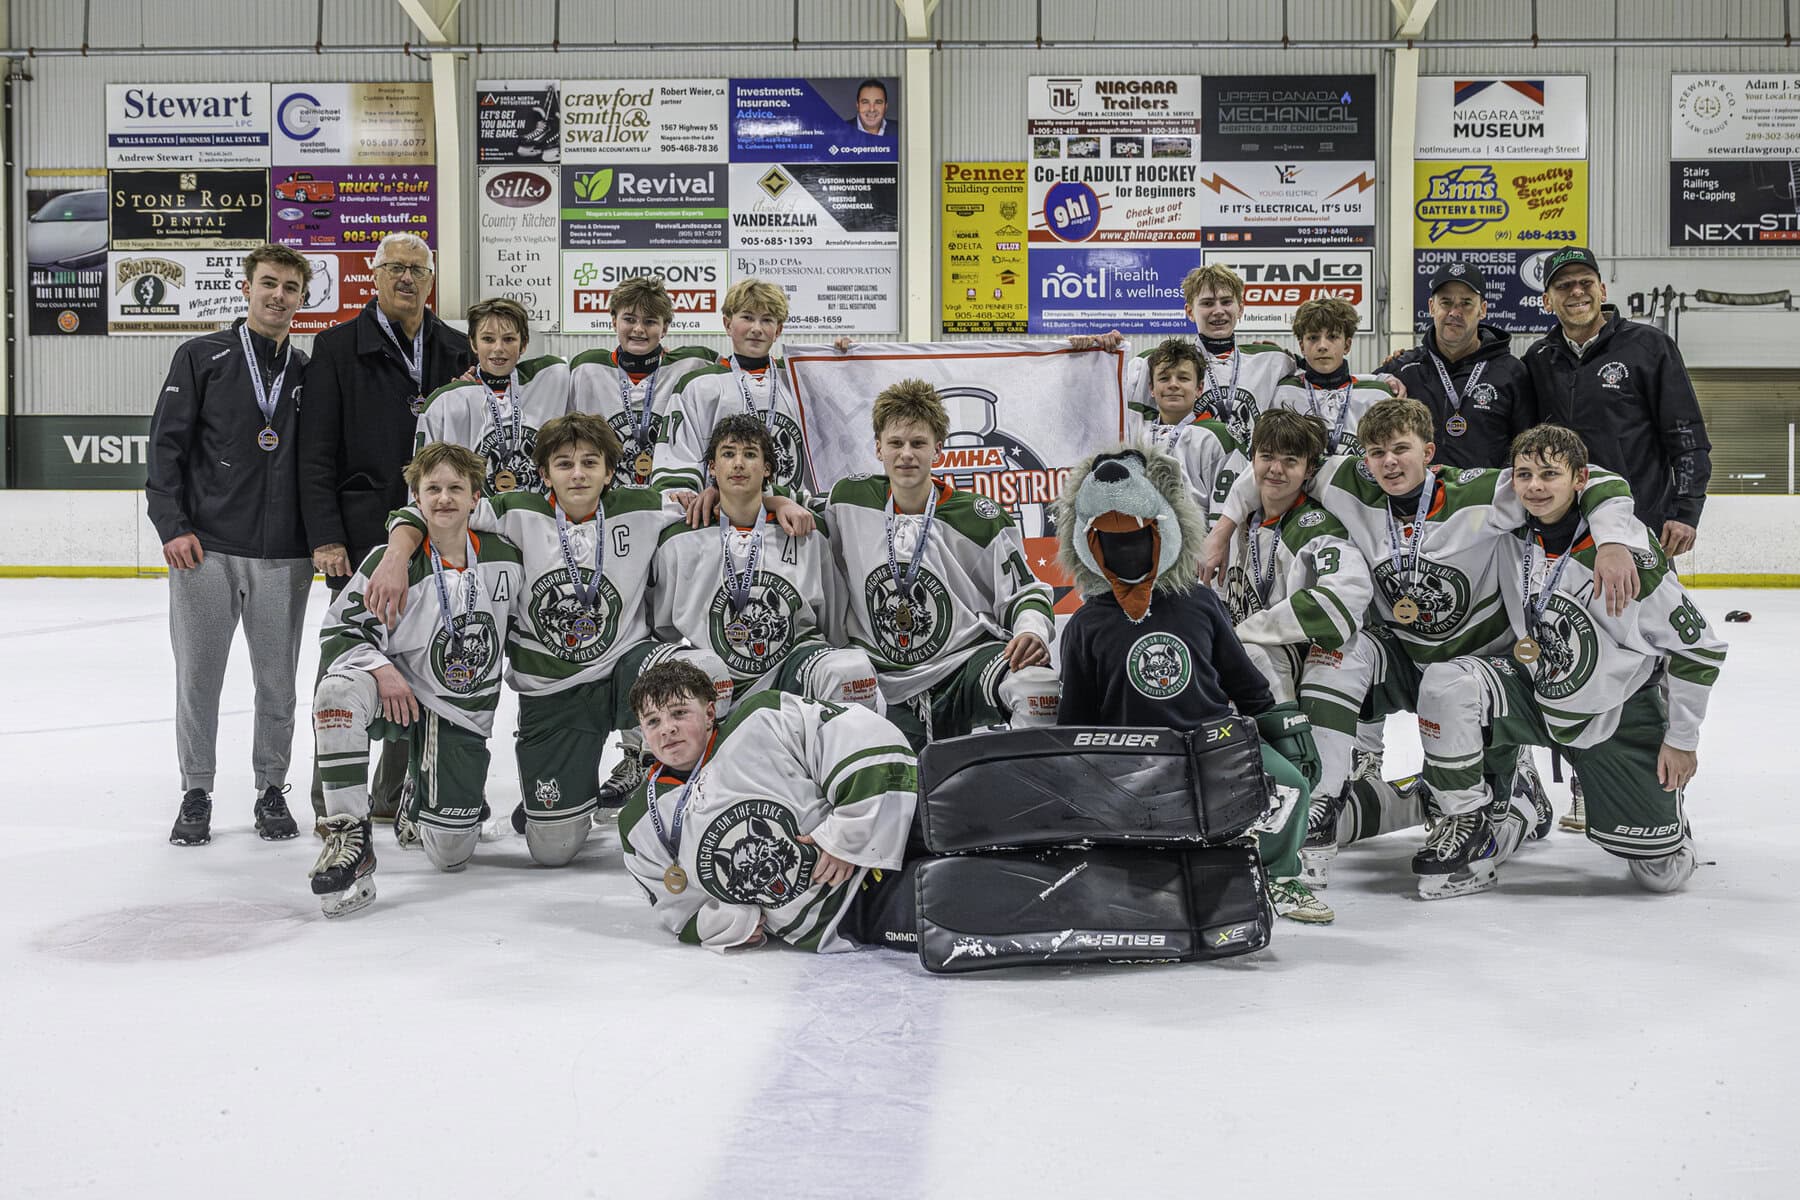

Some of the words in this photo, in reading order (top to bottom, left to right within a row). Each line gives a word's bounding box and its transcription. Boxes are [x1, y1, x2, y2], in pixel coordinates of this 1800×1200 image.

[661, 87, 687, 95] Robert
[689, 87, 715, 96] Weier,
[737, 87, 804, 96] Investments.
[1095, 80, 1178, 94] NIAGARA
[1745, 80, 1778, 89] Adam
[565, 88, 654, 107] crawford
[1218, 91, 1269, 102] UPPER
[1272, 91, 1338, 101] CANADA
[1679, 79, 1717, 110] STEWART
[125, 89, 252, 118] Stewart
[737, 98, 791, 107] Insurance.
[1101, 96, 1169, 110] Trailers
[480, 111, 500, 119] LET'S
[501, 111, 516, 119] GET
[565, 106, 622, 125] smith
[622, 108, 651, 127] &
[737, 109, 777, 118] Advice.
[1218, 107, 1358, 122] MECHANICAL
[1453, 110, 1519, 120] NIAGARA
[481, 120, 495, 128] YOU
[497, 120, 516, 128] BACK
[679, 124, 708, 132] Highway
[1453, 123, 1544, 138] MUSEUM
[481, 130, 495, 138] THE
[496, 130, 519, 138] GAME.
[566, 124, 649, 143] swallow
[841, 145, 890, 154] co-operators
[1419, 145, 1482, 153] notlmuseum.ca
[1507, 145, 1554, 154] Castlereagh
[1555, 145, 1580, 153] Street
[1708, 146, 1800, 155] stewartlawgroup.c
[118, 154, 154, 162] Andrew
[157, 153, 193, 161] Stewart
[944, 164, 1025, 180] Penner
[1034, 165, 1079, 182] Co-Ed
[1083, 165, 1132, 182] ADULT
[1136, 165, 1197, 182] HOCKEY
[1512, 168, 1573, 188] Quality
[1683, 167, 1710, 177] Stairs
[490, 178, 545, 198] Silks
[618, 171, 714, 195] Revival
[947, 184, 989, 195] building
[992, 184, 1023, 194] centre
[1430, 178, 1495, 200] Enns
[1683, 179, 1719, 190] Railings
[1115, 186, 1132, 197] for
[1135, 185, 1196, 199] Beginners
[1517, 181, 1573, 200] Service
[1683, 190, 1736, 202] Re-Capping
[115, 190, 186, 207] STONE
[201, 190, 263, 207] ROAD
[1527, 193, 1568, 210] Since
[1054, 194, 1090, 229] ghl
[1126, 204, 1153, 220] Check
[1155, 205, 1165, 213] us
[1167, 201, 1183, 211] out
[1220, 205, 1229, 213] IF
[1232, 205, 1251, 213] IT'S
[1255, 204, 1318, 214] ELECTRICAL,
[1322, 204, 1340, 212] IT'S
[1344, 204, 1362, 212] US!
[1422, 206, 1468, 215] BATTERY
[1470, 206, 1476, 214] &
[1479, 205, 1502, 214] TIRE
[152, 214, 226, 227] DENTAL
[340, 213, 427, 223] trucknstuff.ca
[482, 213, 516, 230] Country
[522, 213, 556, 228] Kitchen
[733, 213, 817, 226] VANDERZALM
[1136, 216, 1164, 228] online
[1168, 212, 1181, 222] at:
[1100, 231, 1196, 241] www.ghlniagara.com
[1517, 230, 1576, 241] 468-4233
[1684, 223, 1760, 240] NEXT
[206, 257, 236, 267] EAT
[498, 250, 522, 261] Eat
[526, 250, 540, 261] in
[1418, 253, 1457, 263] JOHN
[1461, 253, 1516, 263] FROESE
[117, 260, 183, 284] SANDTRAP
[224, 268, 233, 278] &
[511, 264, 527, 273] or
[602, 266, 717, 283] SIMPSON'S
[760, 267, 825, 275] PROFESSIONAL
[827, 267, 892, 275] CORPORATION
[1114, 267, 1159, 281] health
[1228, 258, 1363, 282] TANCO
[195, 281, 231, 290] TAKE
[485, 275, 523, 287] Take
[527, 276, 552, 287] out
[1041, 267, 1106, 298] notl
[1115, 288, 1123, 298] &
[1126, 285, 1185, 298] wellness
[188, 299, 210, 309] What
[197, 308, 218, 317] after
[220, 306, 232, 315] the
[290, 321, 328, 329] Genuine
[658, 411, 684, 446] 17
[63, 435, 150, 464] VISIT
[612, 525, 630, 557] C
[782, 536, 797, 566] A
[561, 539, 582, 586] CHAMPION
[741, 544, 757, 592] CHAMPION
[492, 570, 511, 602] A
[1669, 592, 1707, 645] 88
[542, 634, 571, 660] WOLVES
[574, 639, 607, 661] HOCKEY
[908, 640, 938, 663] HOCKEY
[727, 653, 761, 671] WOLVES
[1074, 732, 1160, 748] BAUER
[1206, 723, 1233, 743] 3X
[440, 807, 481, 817] BAUE
[647, 784, 663, 833] CHAMPION
[1614, 821, 1679, 837] BAUER
